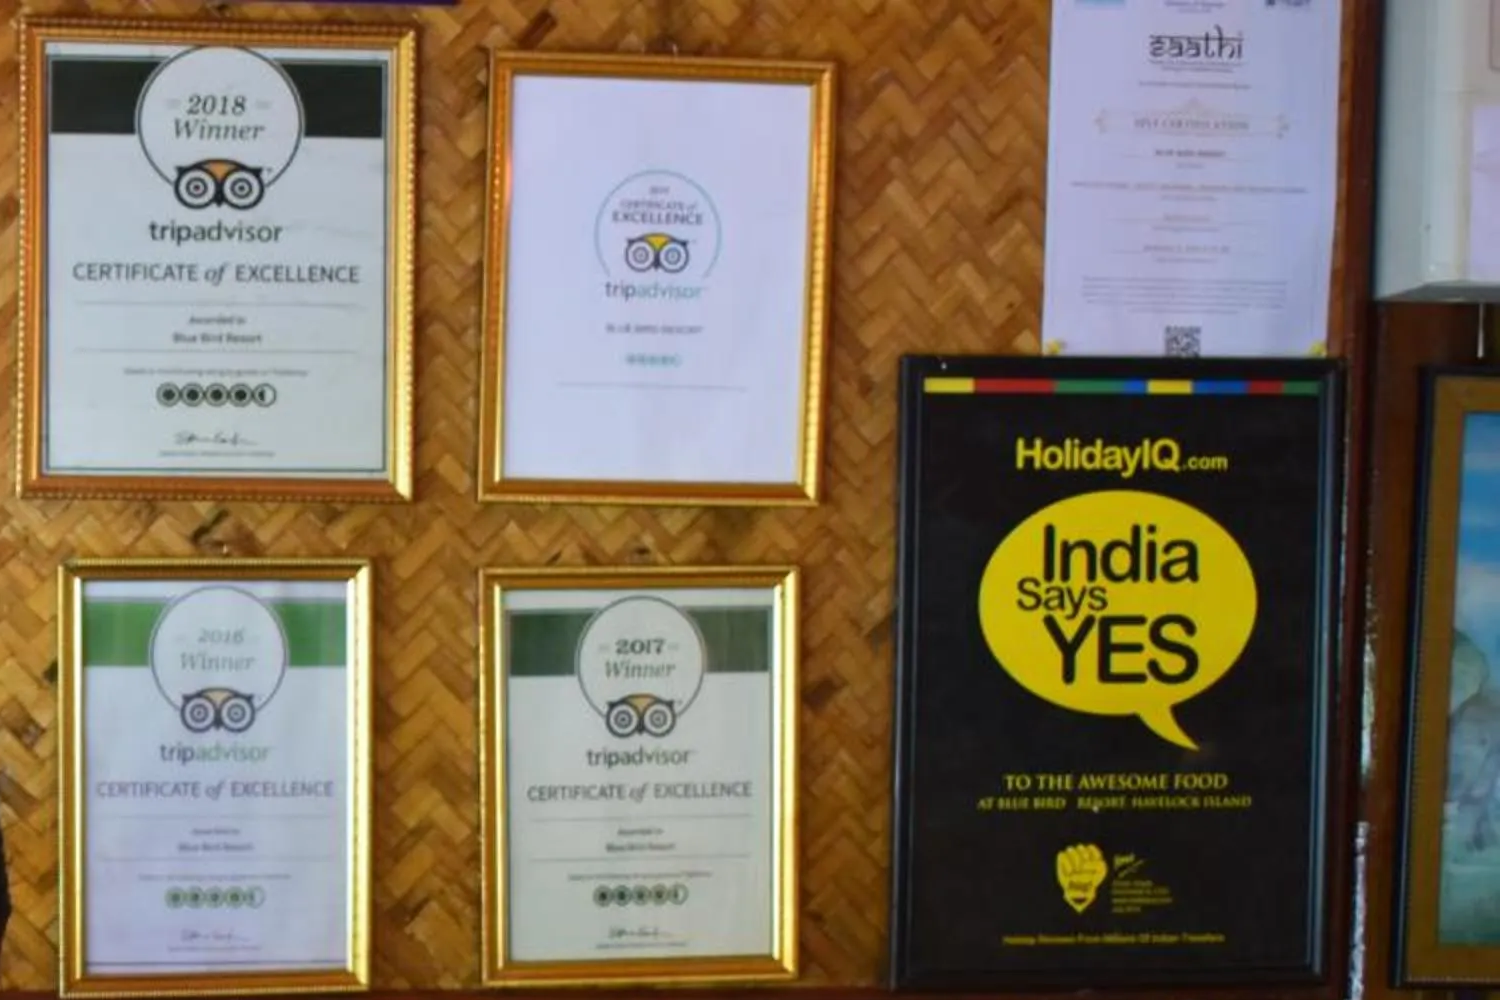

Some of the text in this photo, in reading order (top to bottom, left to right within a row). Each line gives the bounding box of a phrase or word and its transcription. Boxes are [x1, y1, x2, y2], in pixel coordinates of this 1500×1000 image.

[187, 95, 247, 116] 2018
[174, 119, 266, 141] Winner
[612, 210, 703, 226] EXCELLENCE
[149, 221, 283, 246] tripadvisor
[72, 261, 360, 286] CERTIFICATE of EXCELLENCE
[605, 280, 703, 301] tripadvisor
[1043, 523, 1200, 583] India
[1016, 577, 1108, 620] Says
[197, 627, 247, 644] 2016
[615, 638, 667, 655] 2017
[1042, 614, 1200, 686] YES
[180, 652, 256, 671] Winner
[604, 660, 676, 679] Winner
[160, 743, 270, 764] tripadvisor
[587, 747, 690, 769] tripadvisor
[96, 780, 334, 800] CERTIFICATE of EXCELLENCE
[527, 780, 752, 803] CERTIFICATE of EXCELLENCE
[1004, 772, 1228, 791] TO THE AWESOME FOOD
[1033, 796, 1066, 810] BIRD
[1203, 795, 1252, 808] ISLAND
